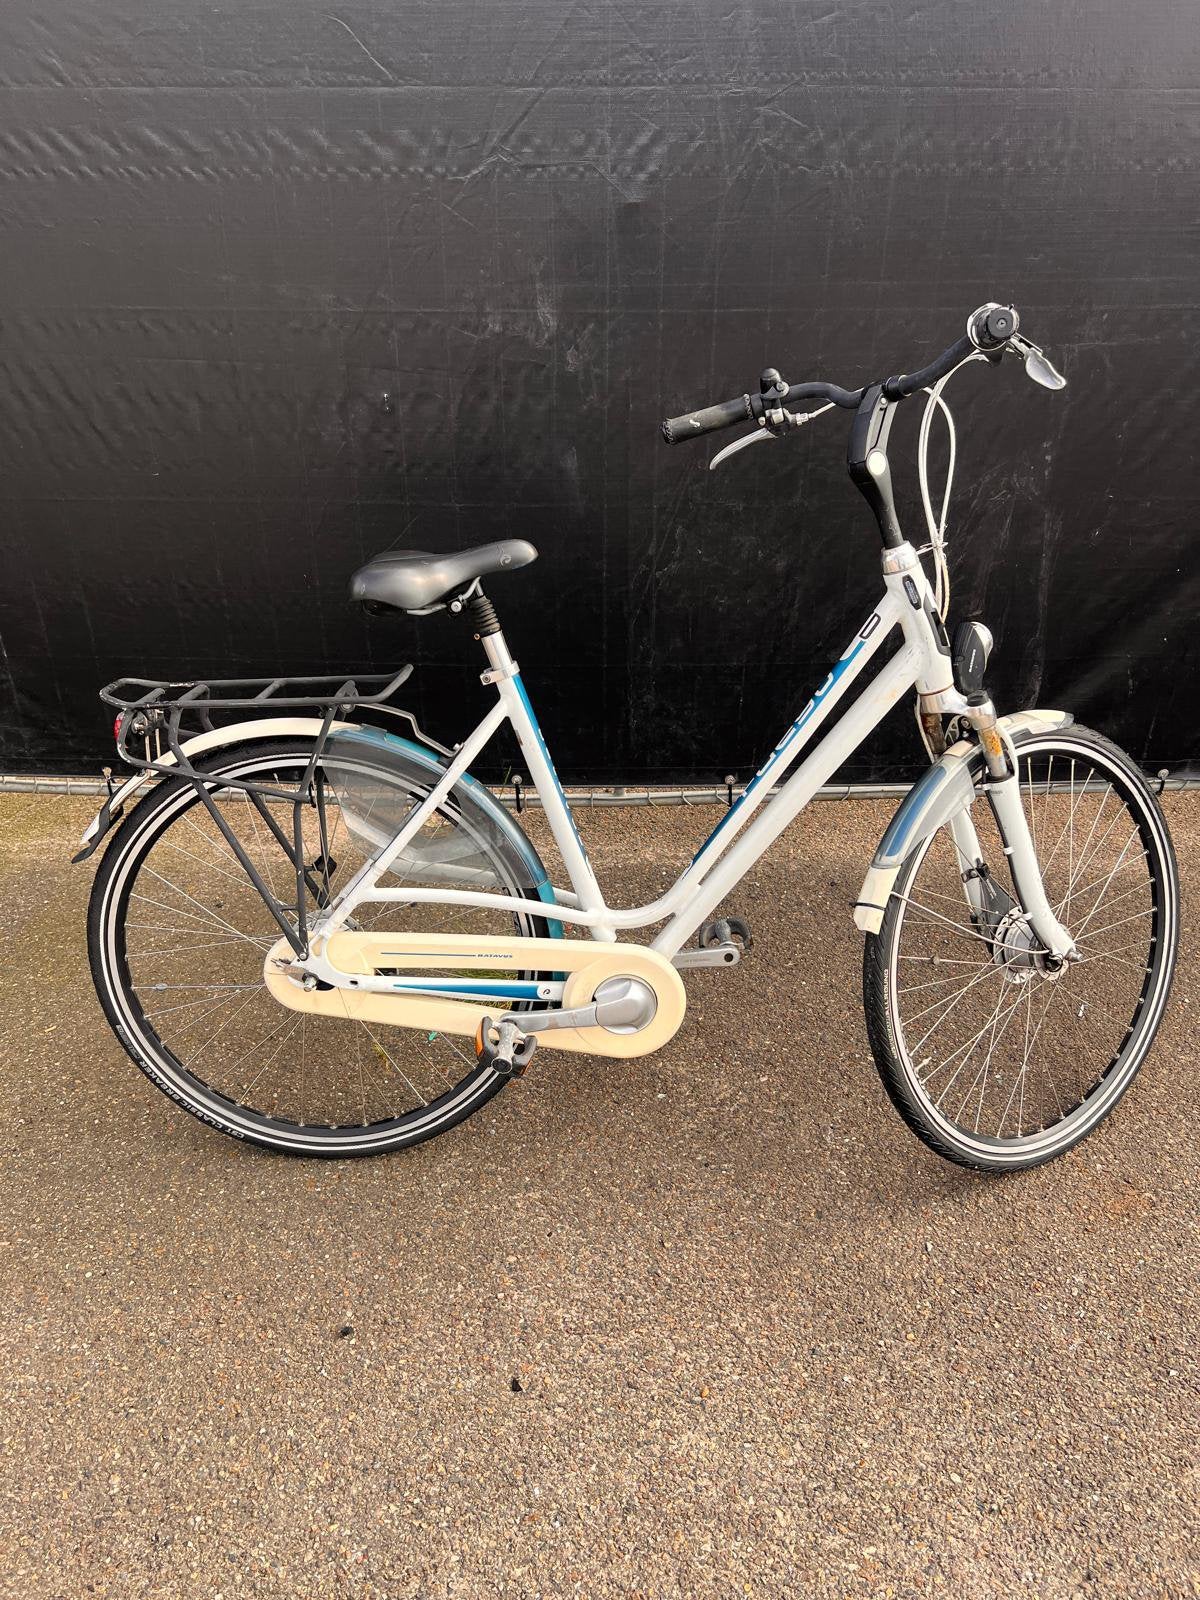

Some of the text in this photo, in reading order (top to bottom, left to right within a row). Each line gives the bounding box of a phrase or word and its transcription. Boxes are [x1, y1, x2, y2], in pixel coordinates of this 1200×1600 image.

[139, 1059, 245, 1140] CST CLASSIC BREAKER
